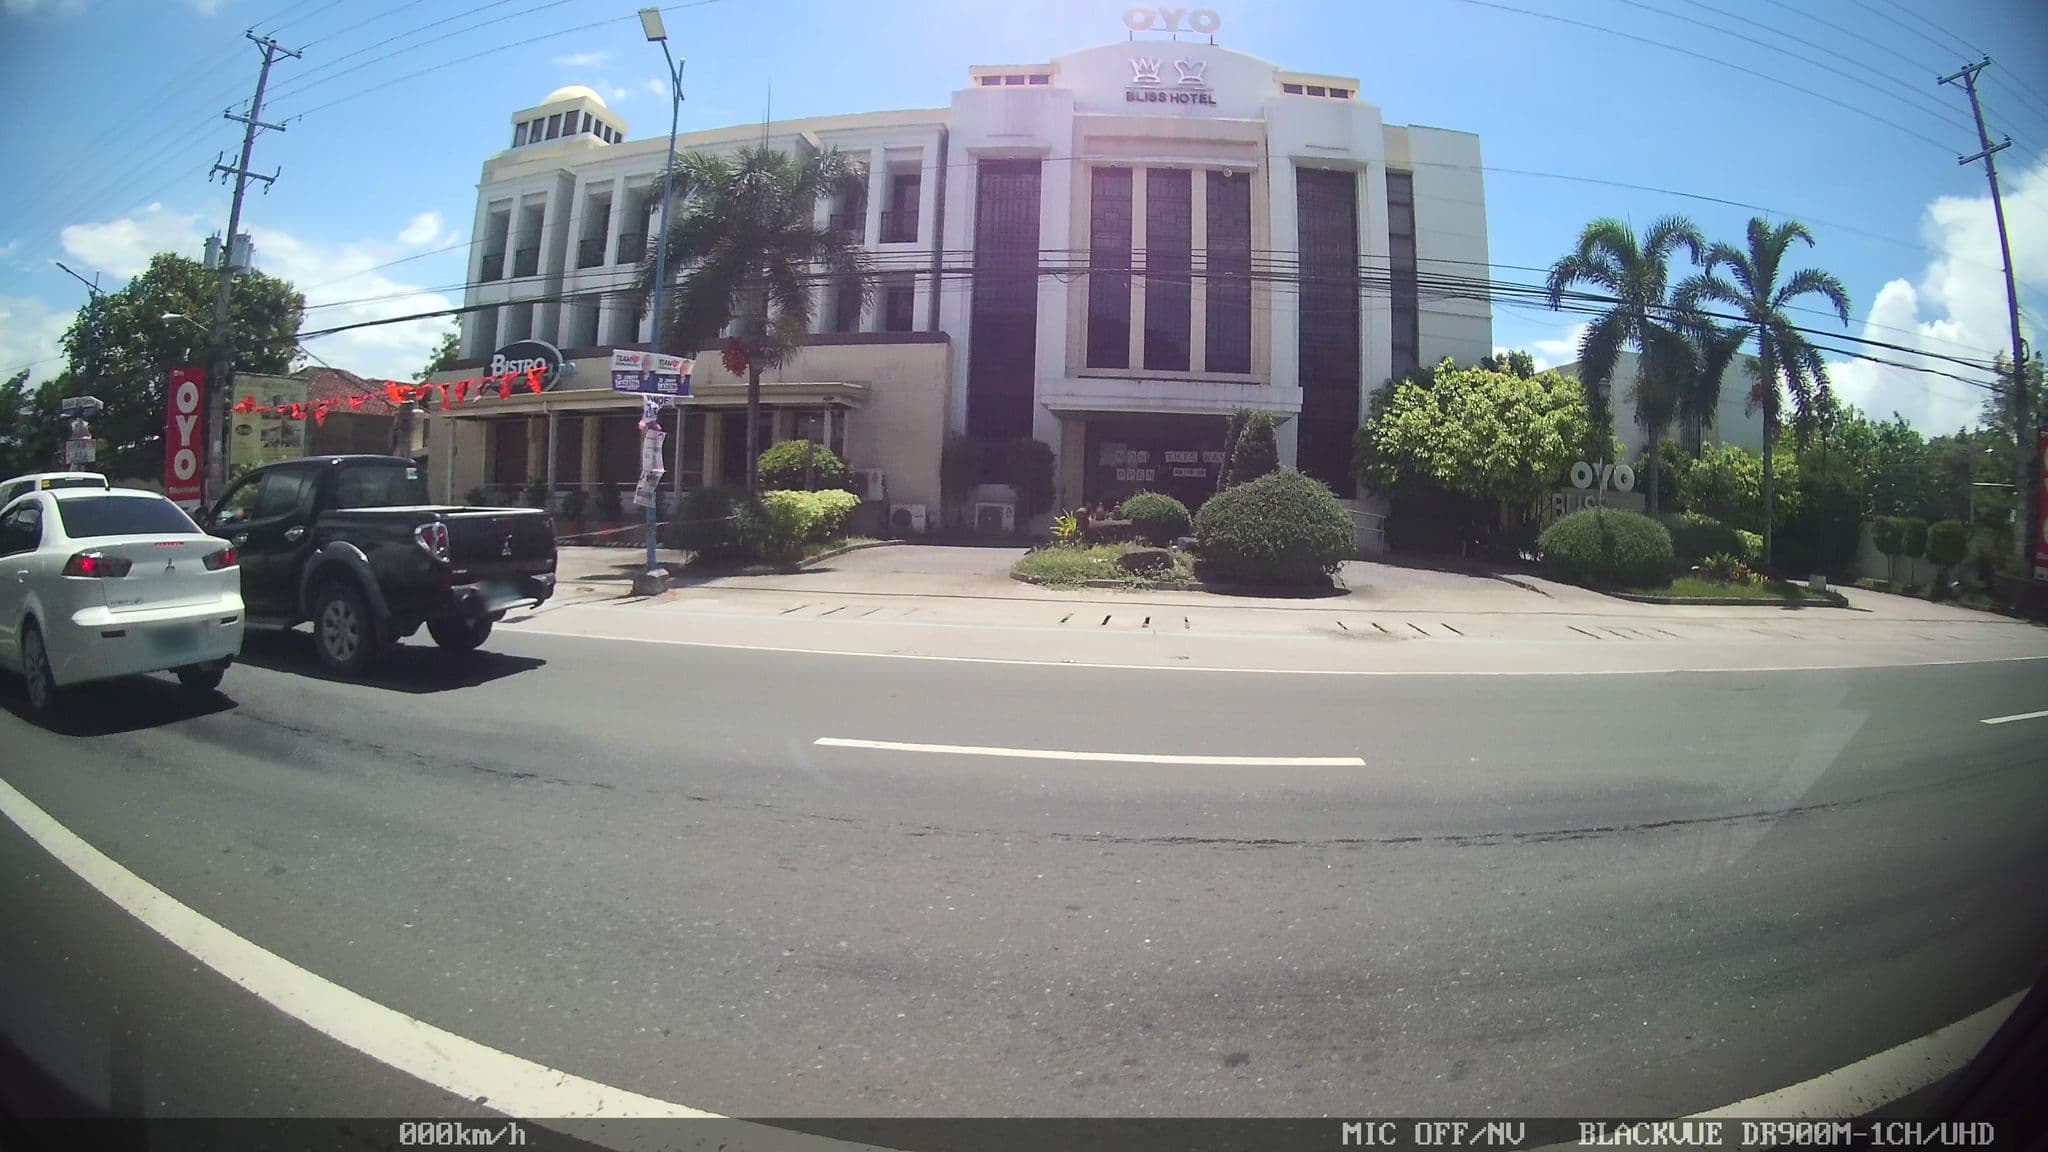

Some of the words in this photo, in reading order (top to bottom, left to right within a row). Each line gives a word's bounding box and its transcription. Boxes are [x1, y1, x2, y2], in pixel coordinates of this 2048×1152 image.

[1123, 7, 1221, 33] OYO
[1126, 91, 1167, 103] BLISS
[1170, 93, 1217, 105] HOTEL
[174, 381, 199, 480] OYO
[1570, 461, 1635, 492] OYO
